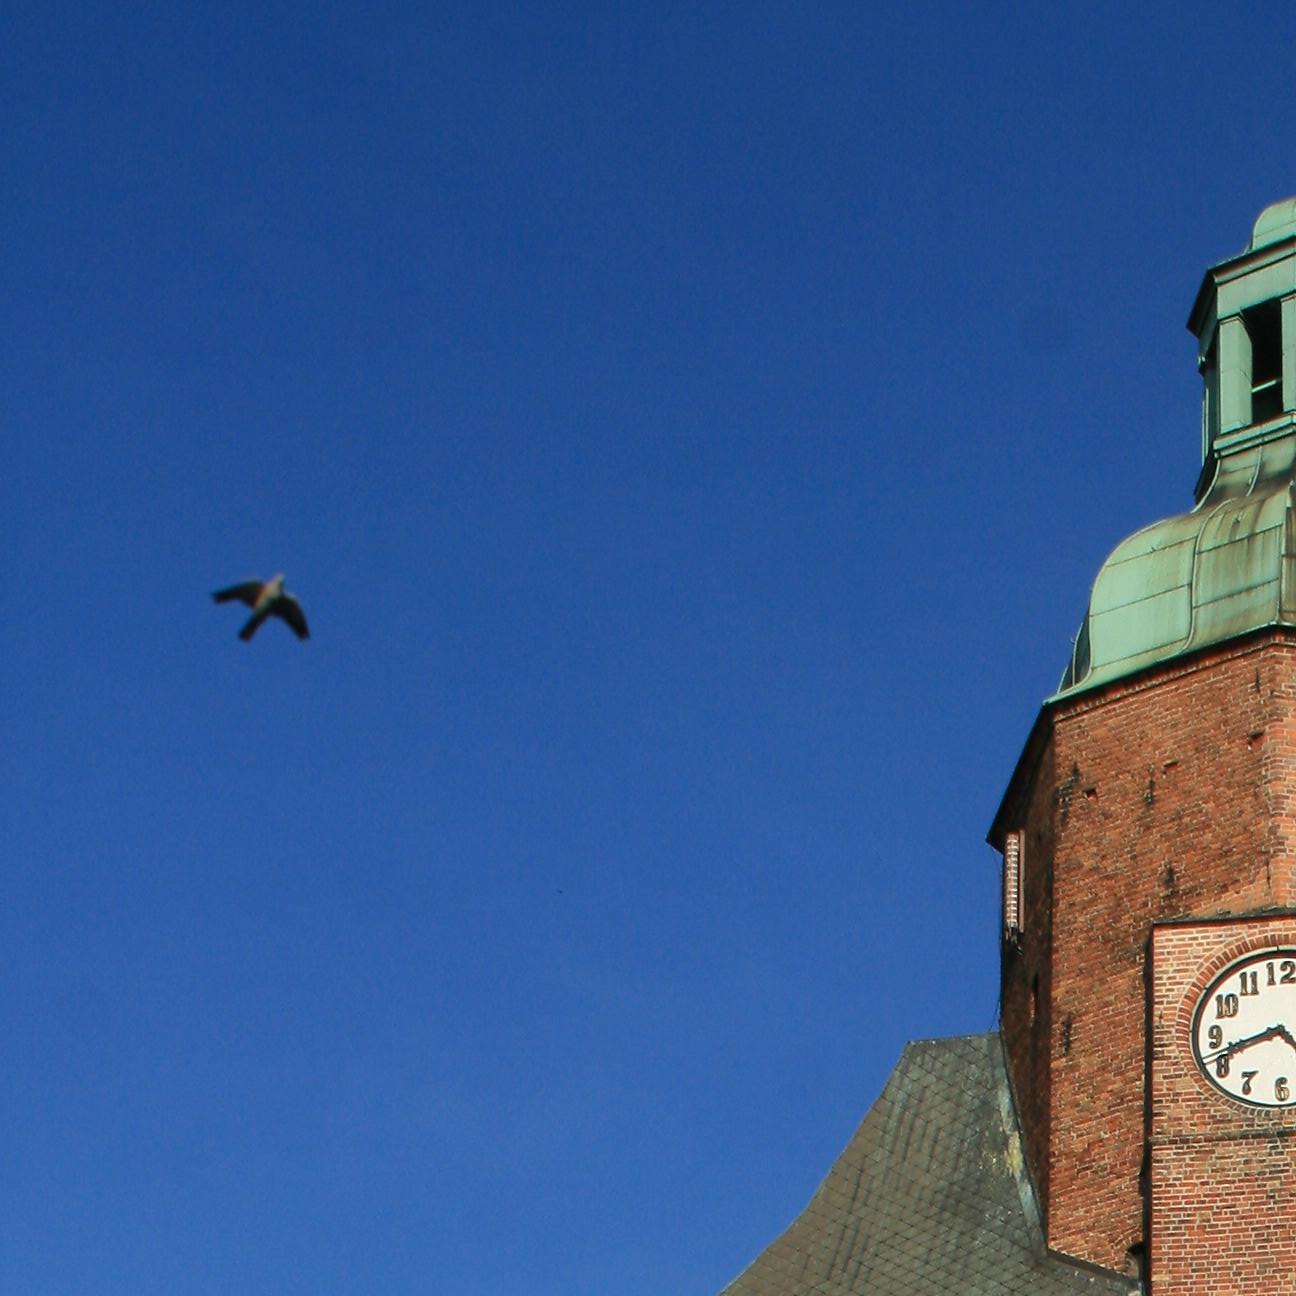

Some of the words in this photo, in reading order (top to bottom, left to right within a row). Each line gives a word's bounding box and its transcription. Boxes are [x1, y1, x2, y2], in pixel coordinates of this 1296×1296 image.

[1239, 971, 1259, 996] 11
[1266, 961, 1296, 986] 12
[1215, 994, 1239, 1019] 10
[1208, 1025, 1223, 1049] 9
[1216, 1053, 1230, 1079] 8
[1241, 1070, 1259, 1095] 7
[1274, 1076, 1290, 1101] 6
